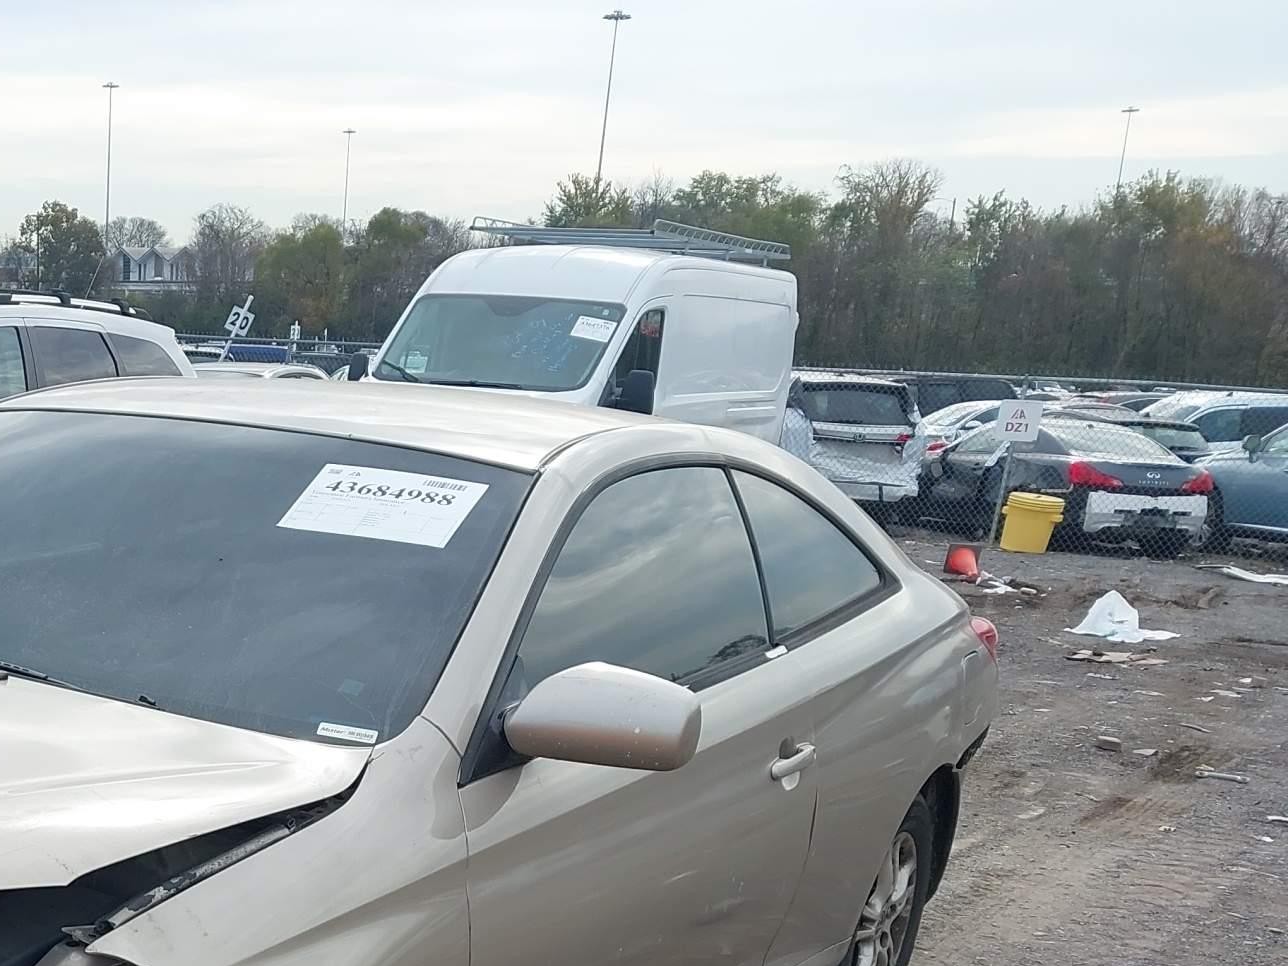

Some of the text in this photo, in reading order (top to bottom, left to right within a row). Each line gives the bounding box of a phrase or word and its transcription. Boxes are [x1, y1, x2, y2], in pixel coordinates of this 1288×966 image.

[229, 312, 249, 330] 20
[1004, 422, 1029, 433] DZ1
[325, 478, 458, 507] 43684988
